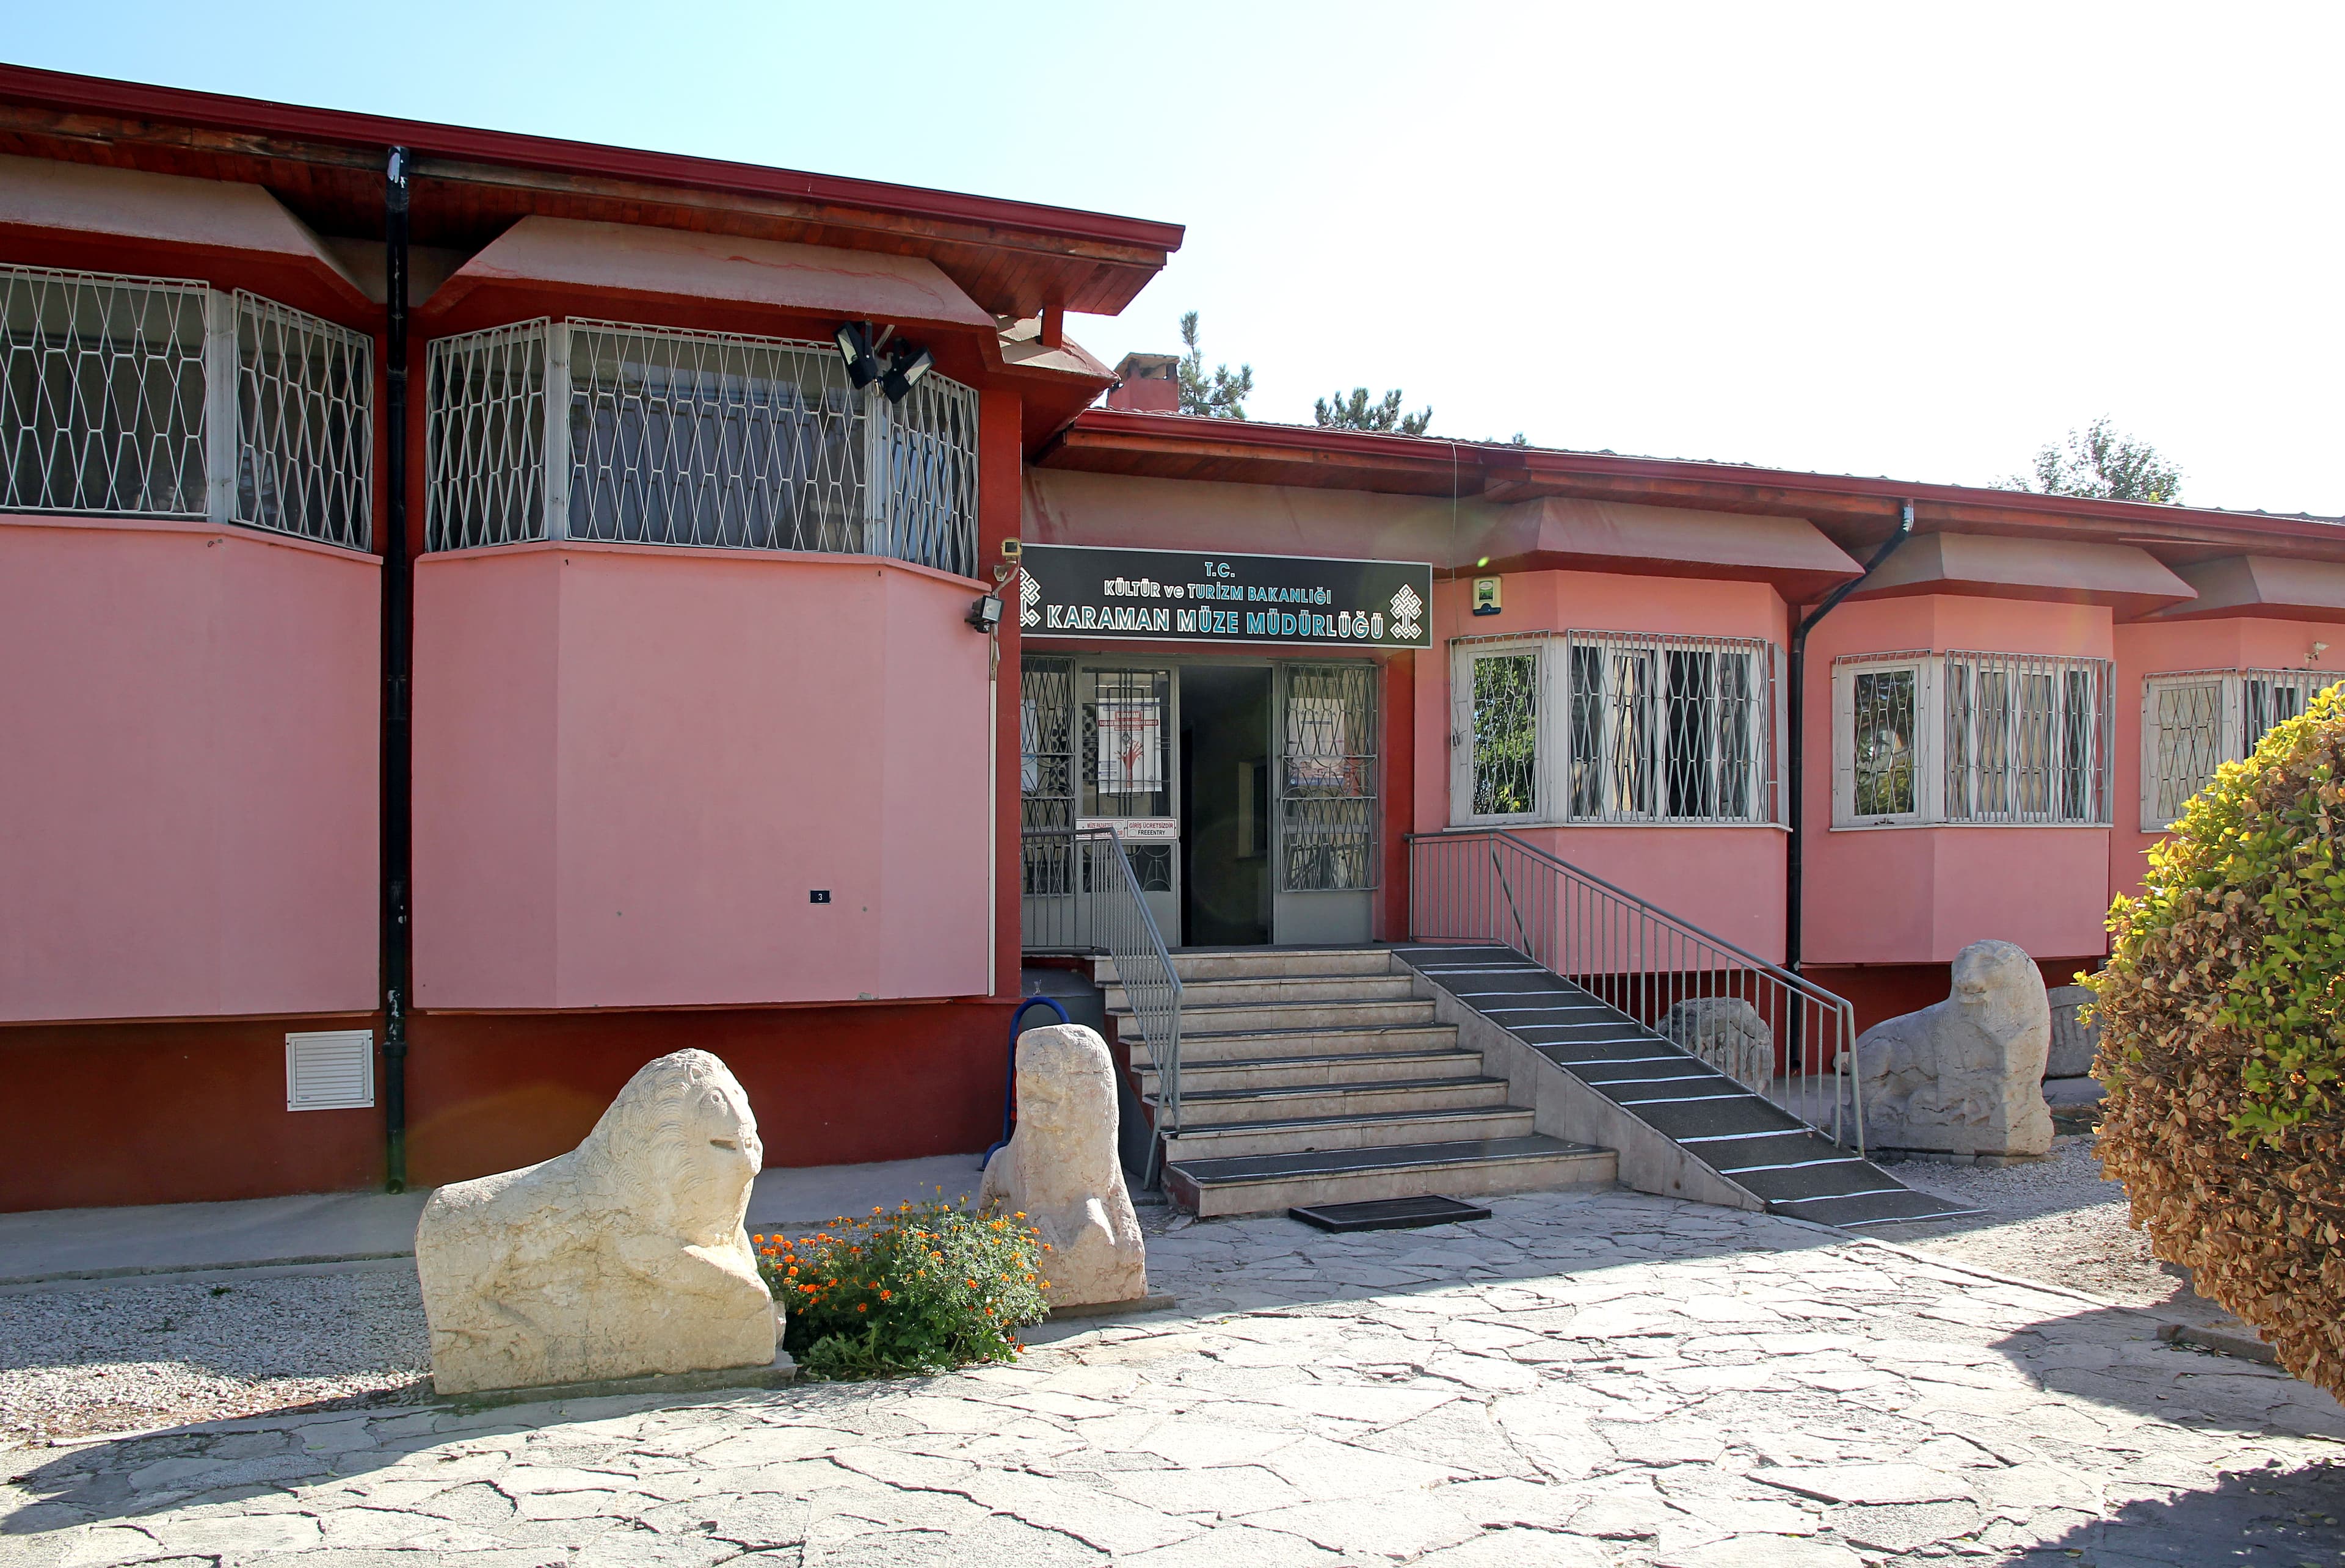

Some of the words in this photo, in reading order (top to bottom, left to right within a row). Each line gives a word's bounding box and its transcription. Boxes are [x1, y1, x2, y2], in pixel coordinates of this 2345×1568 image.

[1205, 561, 1235, 578] T.C.
[1104, 577, 1161, 598] KÜLTÜR
[1163, 585, 1184, 599] ve
[1187, 581, 1243, 601] TURİZM
[1248, 586, 1331, 604] BAKANLIĞI
[1047, 604, 1169, 631] KARAMAN
[1177, 605, 1238, 634] MÜZE
[1246, 608, 1384, 639] MÜDÜRLÜĞÜ
